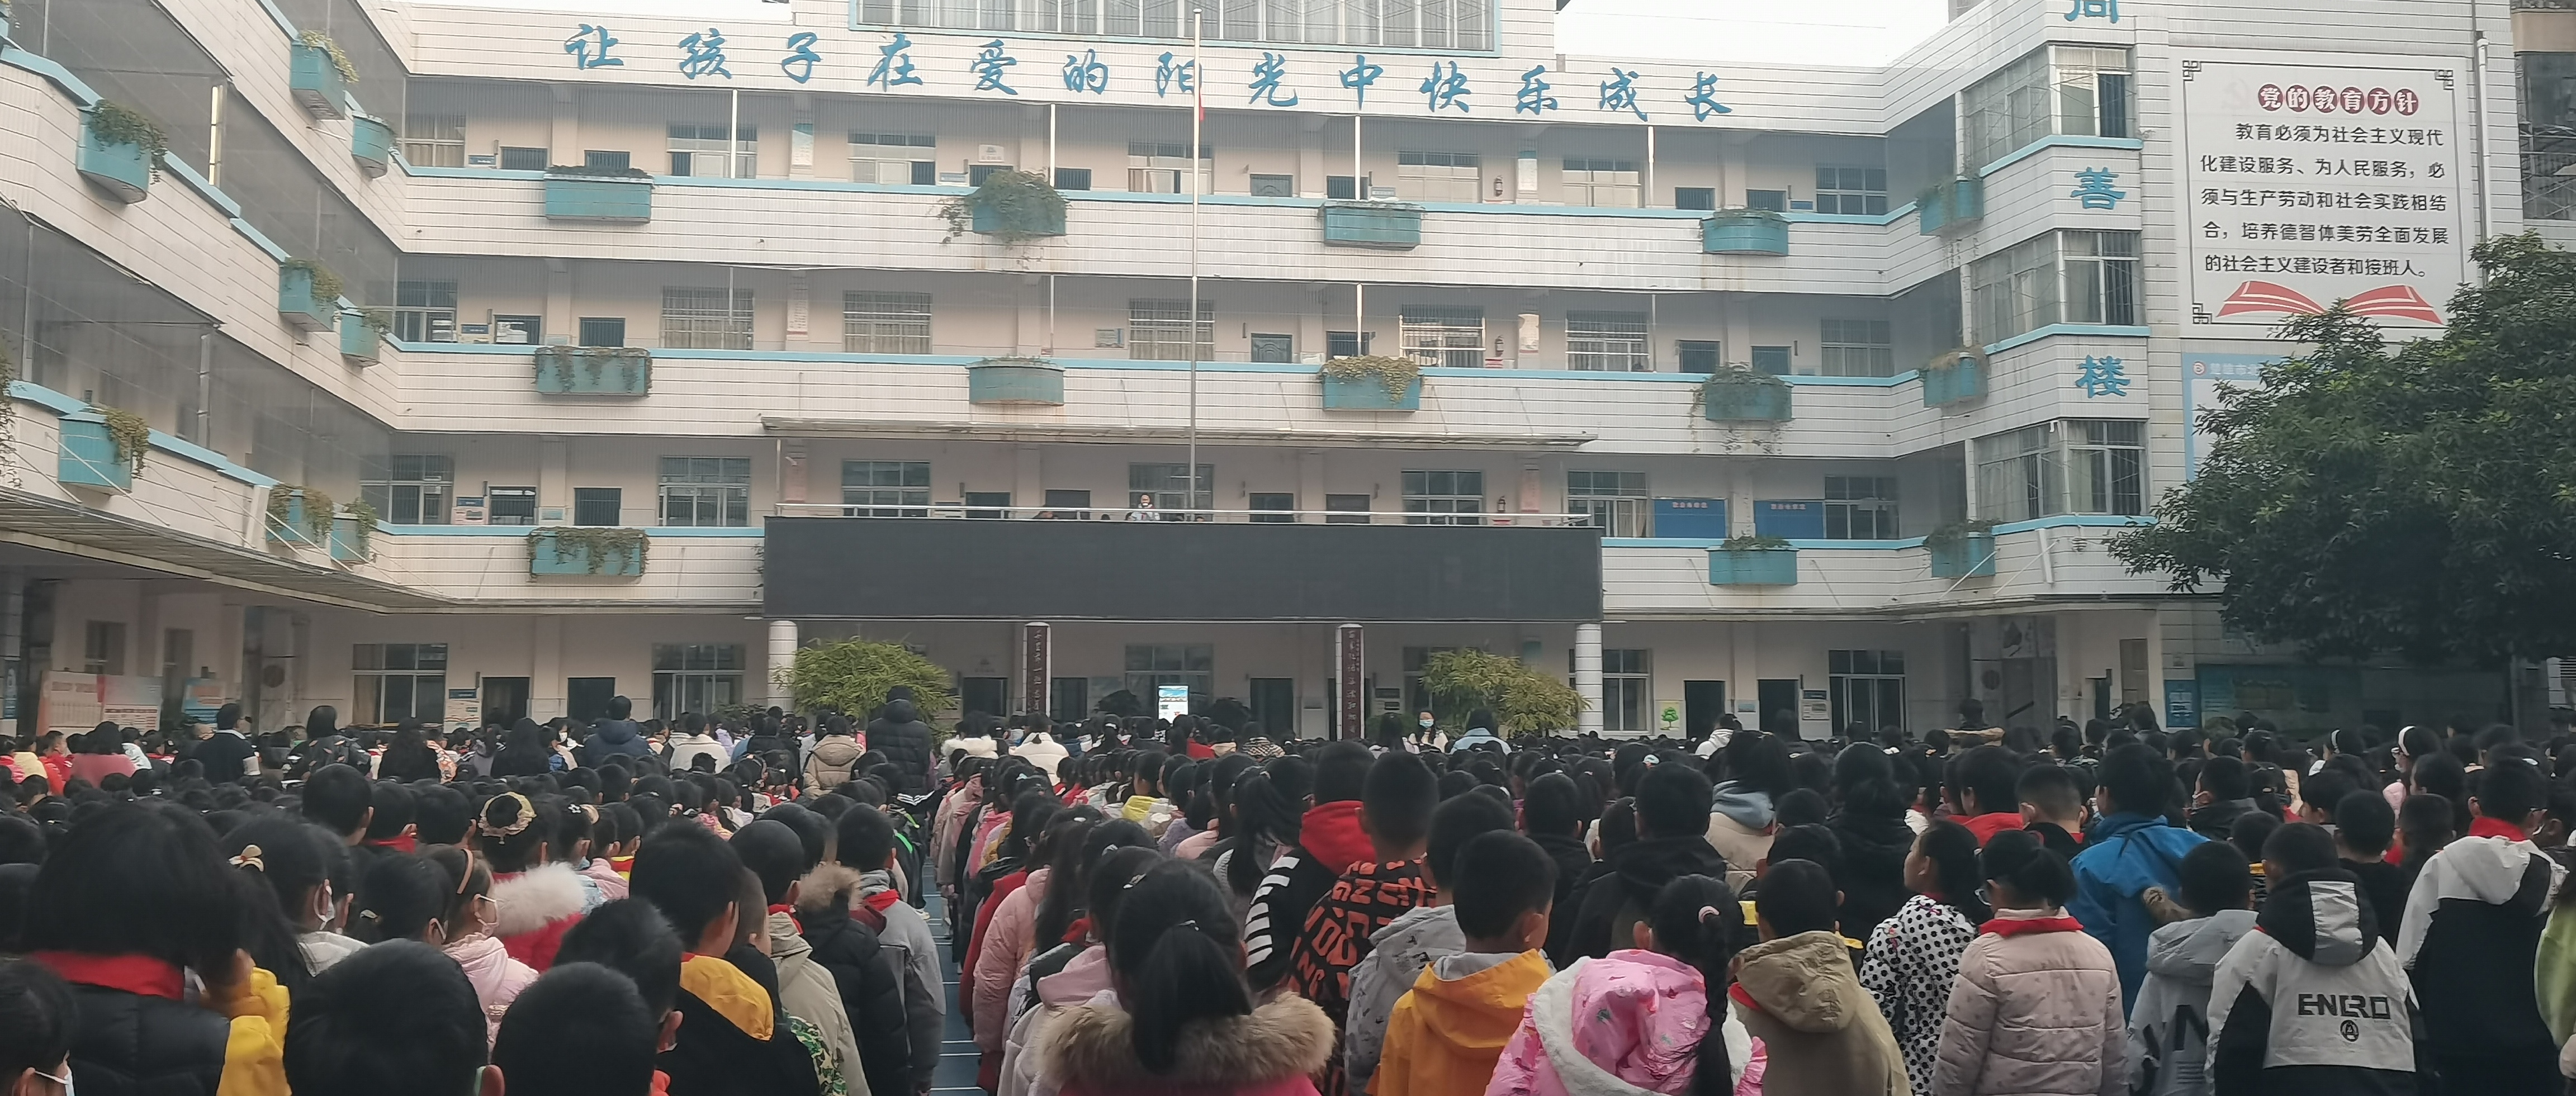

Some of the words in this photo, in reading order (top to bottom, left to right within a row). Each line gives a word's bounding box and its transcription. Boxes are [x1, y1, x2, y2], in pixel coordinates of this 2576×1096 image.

[565, 23, 1732, 122] 让孩子在爱的阳光中快乐成长
[2260, 87, 2418, 114] 党的教育方针
[2236, 123, 2444, 146] 教育必须为社会主义现代
[2201, 188, 2447, 211] 须与生产劳动和社会实践相结
[2203, 221, 2449, 244] 合，培养德智体美劳全面发展
[2205, 254, 2426, 278] 的社会主义建设者和接班人。
